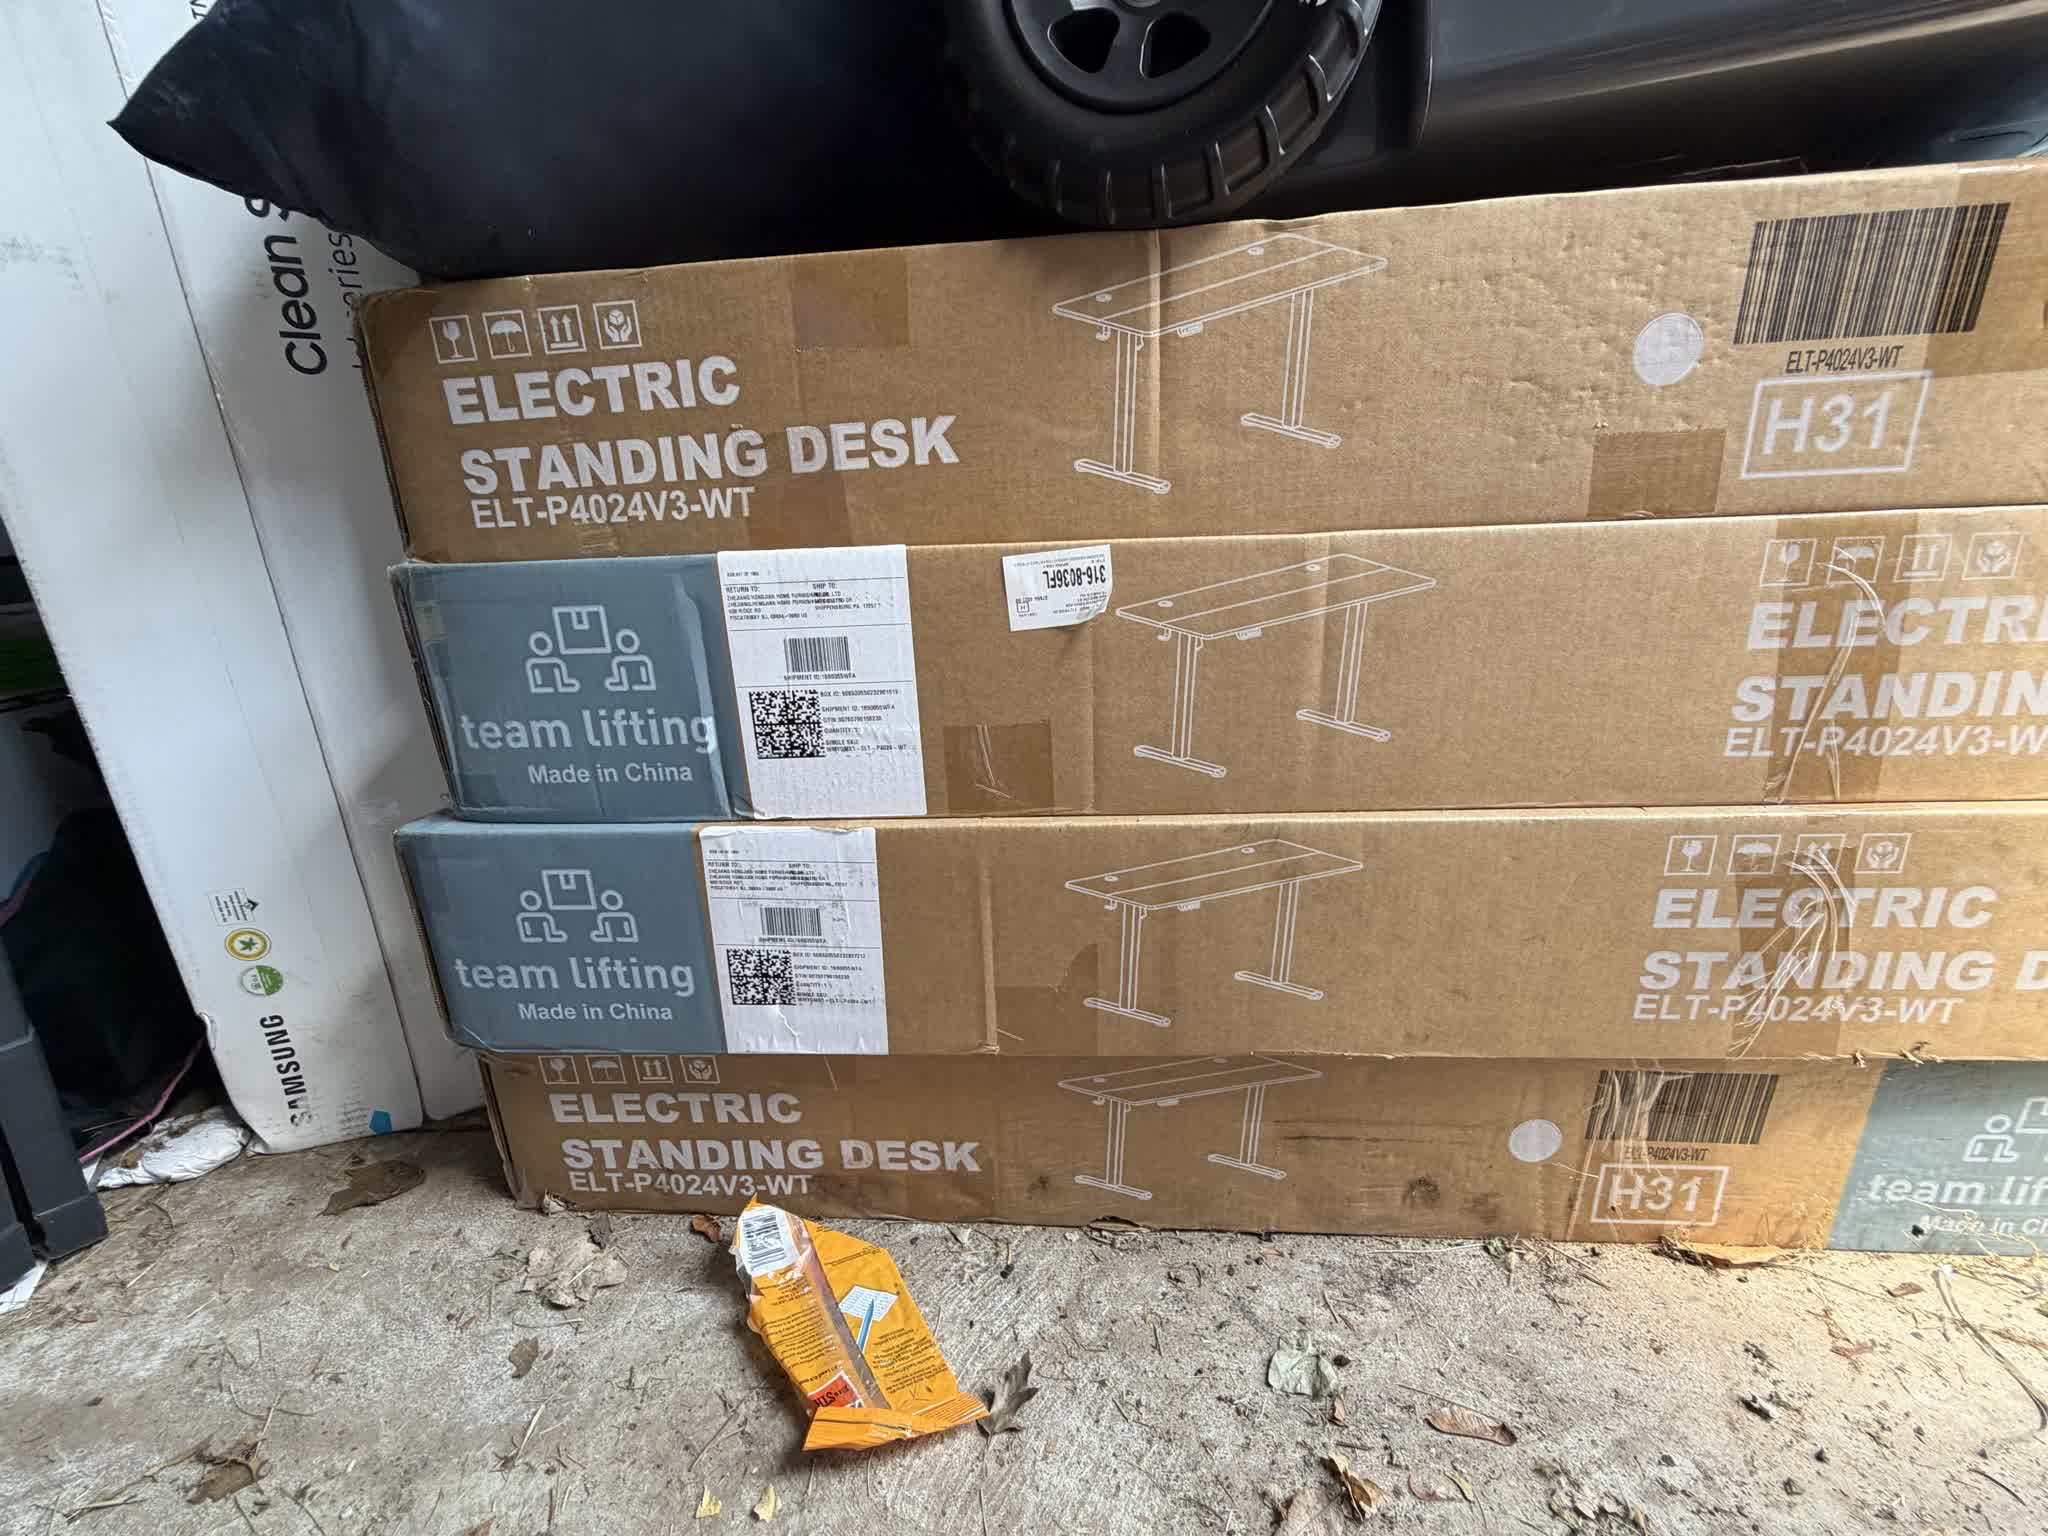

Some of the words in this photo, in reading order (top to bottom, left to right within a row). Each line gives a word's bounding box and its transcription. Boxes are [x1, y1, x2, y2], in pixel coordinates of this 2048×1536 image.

[264, 235, 327, 375] Clean
[1785, 345, 1904, 373] ELT-P4024V3-WT
[441, 355, 741, 425] ELECTRIC
[1762, 391, 1892, 455] H31
[461, 427, 769, 495] STANDING
[785, 415, 960, 474] DESK
[470, 485, 756, 529] ELT-P4024V3-WT
[812, 582, 828, 590] SHIP
[1042, 565, 1106, 589] 316-8036FL
[1731, 670, 2048, 722] STANDIN
[460, 714, 572, 749] team
[581, 709, 717, 754] lifting
[1724, 725, 2048, 758] ELT-P4024V3-W
[527, 764, 591, 784] Made
[596, 763, 618, 782] in
[625, 762, 693, 782] China
[1651, 886, 1999, 928] ELECTRIC
[454, 958, 559, 989] team
[568, 957, 696, 997] lifting
[1638, 950, 1997, 992] STANDING
[518, 1003, 577, 1020] Made
[581, 1003, 603, 1020] in
[609, 1002, 673, 1020] China
[1632, 993, 1964, 1024] ELT-P4024V3-WT
[259, 1013, 312, 1127] SAMSUNG
[549, 1092, 803, 1125] ELECTRIC
[562, 1138, 825, 1171] STANDING
[839, 1139, 983, 1172] DESK
[568, 1171, 812, 1197] ELT-P4024V3-WT
[1607, 1174, 1702, 1212] H31
[1868, 1174, 1986, 1205] team
[2000, 1175, 2048, 1206] lif
